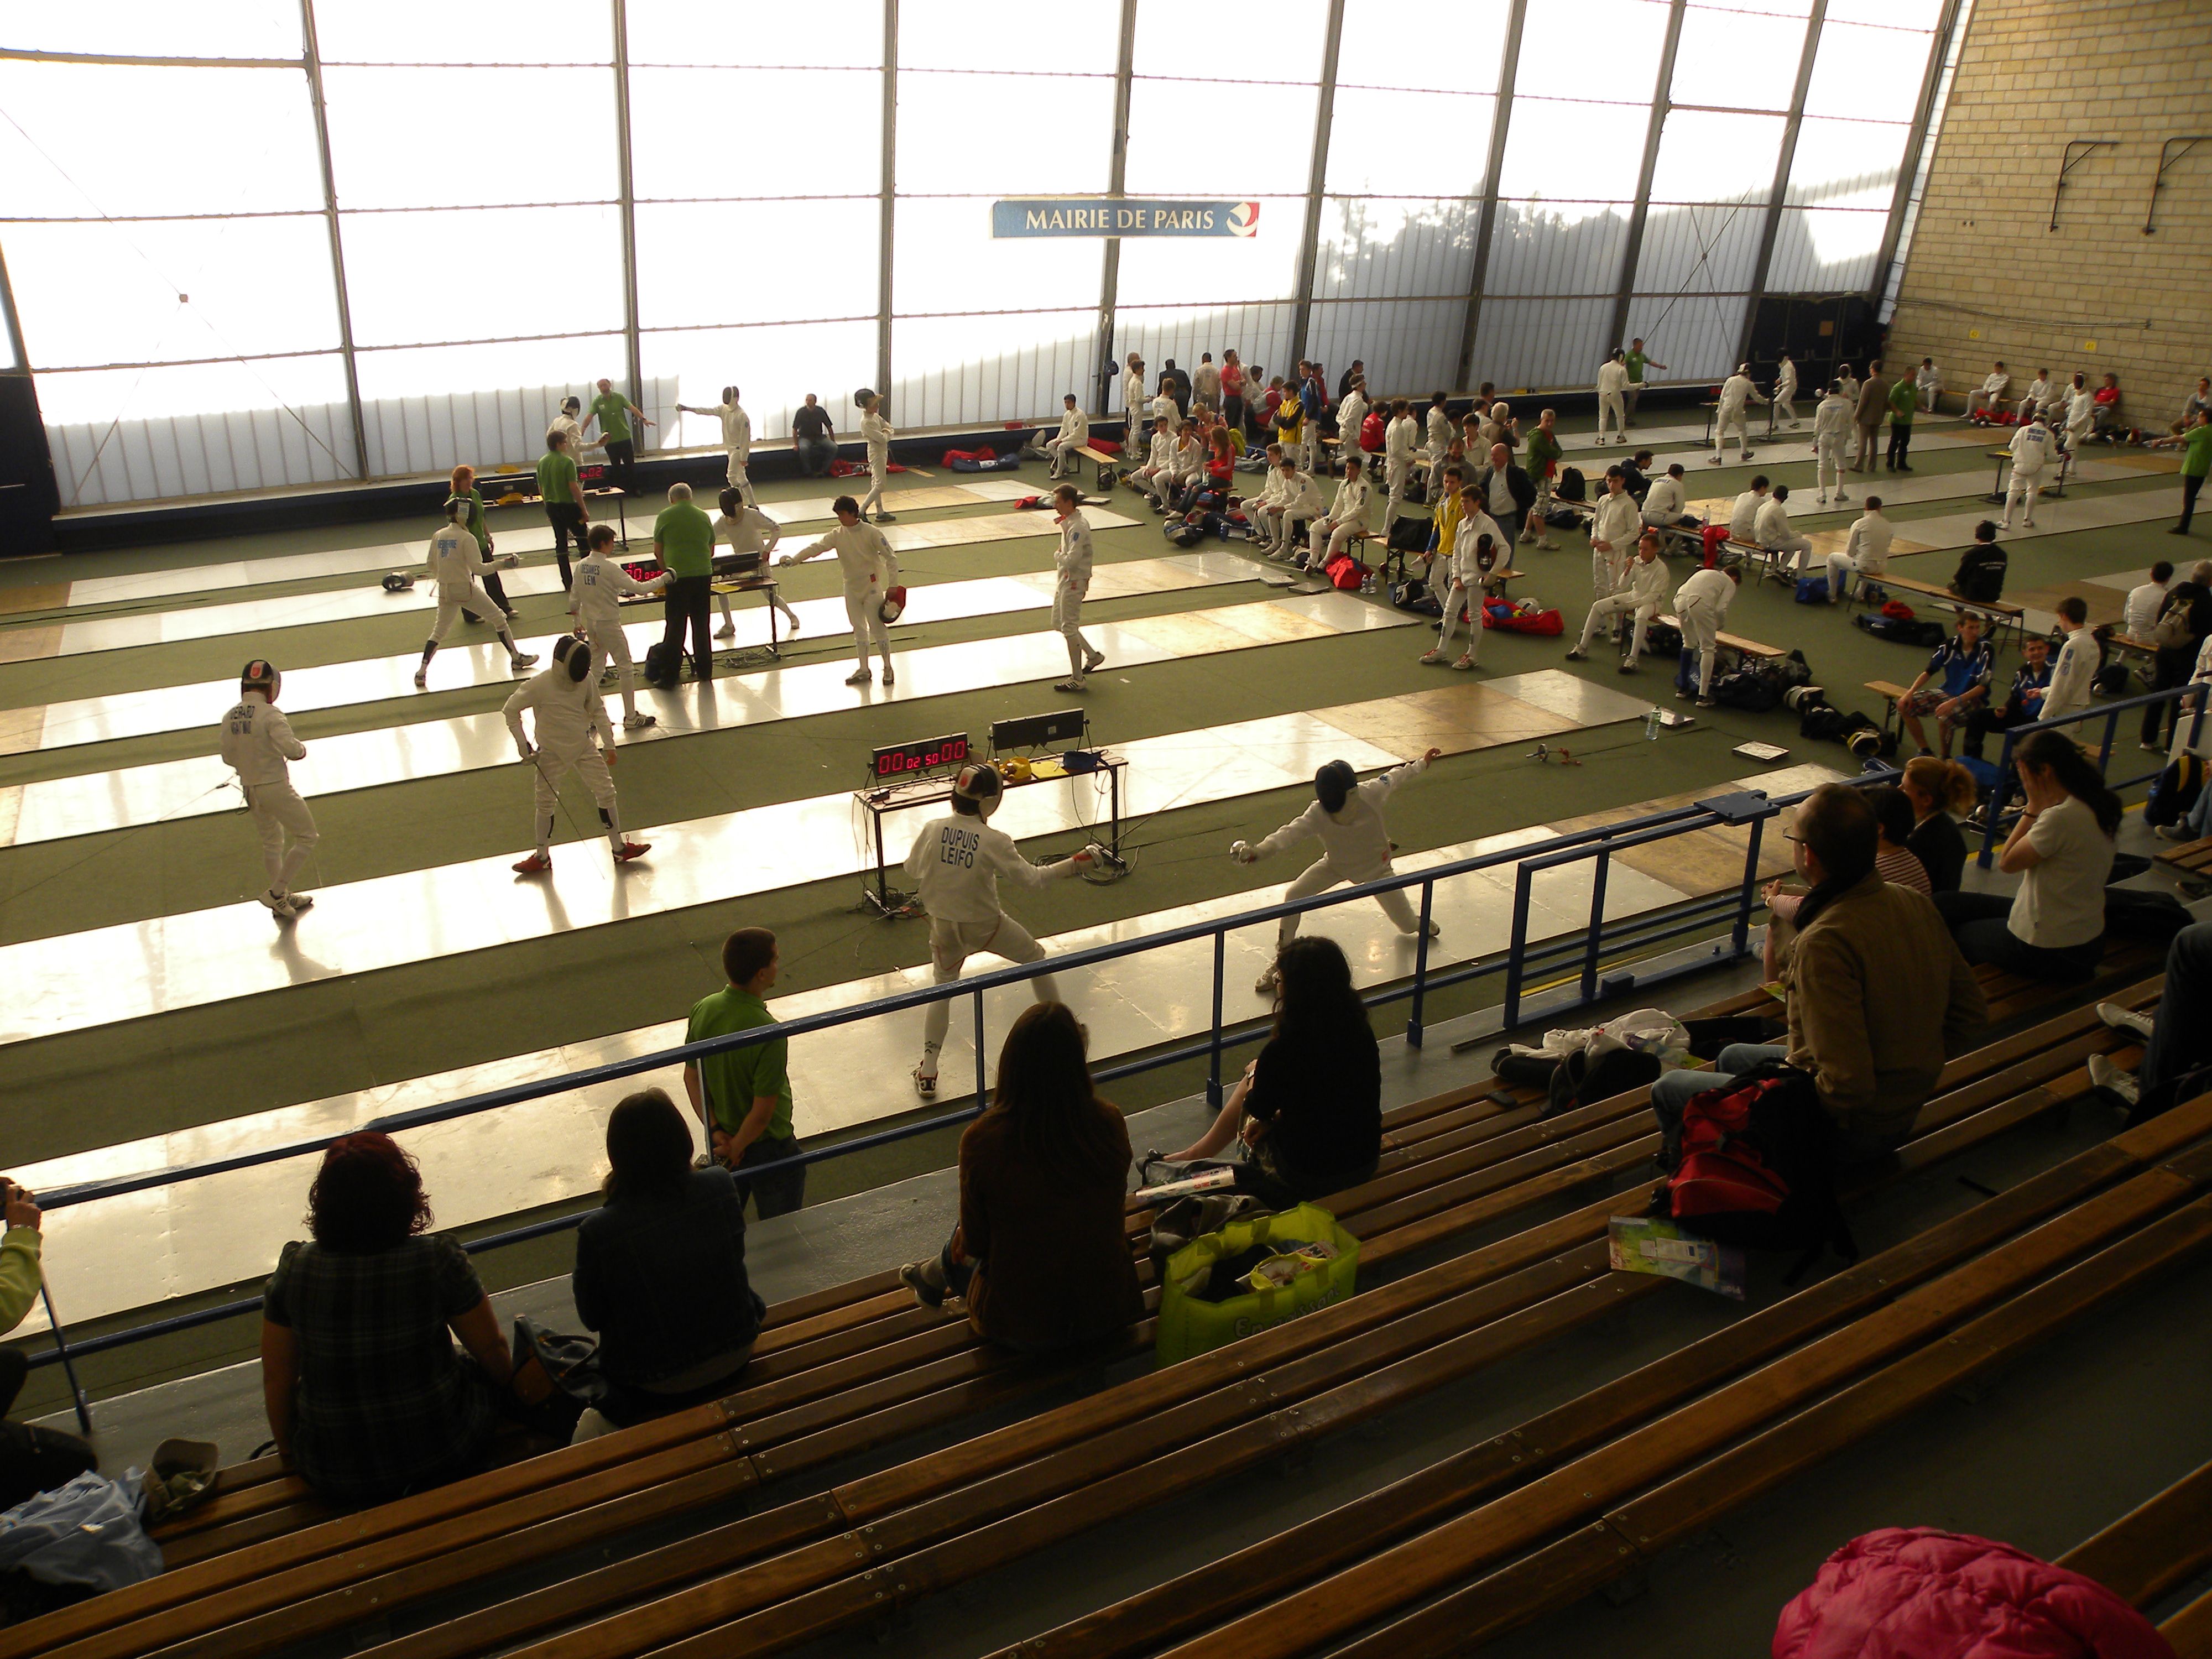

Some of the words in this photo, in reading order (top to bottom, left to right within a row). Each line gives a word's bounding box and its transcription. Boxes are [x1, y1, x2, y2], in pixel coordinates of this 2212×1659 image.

[1025, 210, 1110, 230] MAIRIE
[1117, 210, 1146, 229] DE
[1154, 210, 1214, 230] PARIS
[878, 753, 904, 774] 00
[906, 757, 921, 769] 02
[925, 753, 940, 765] 50
[941, 741, 966, 761] 00
[941, 827, 979, 851] DUPUIS
[941, 846, 973, 869] LEIFO
